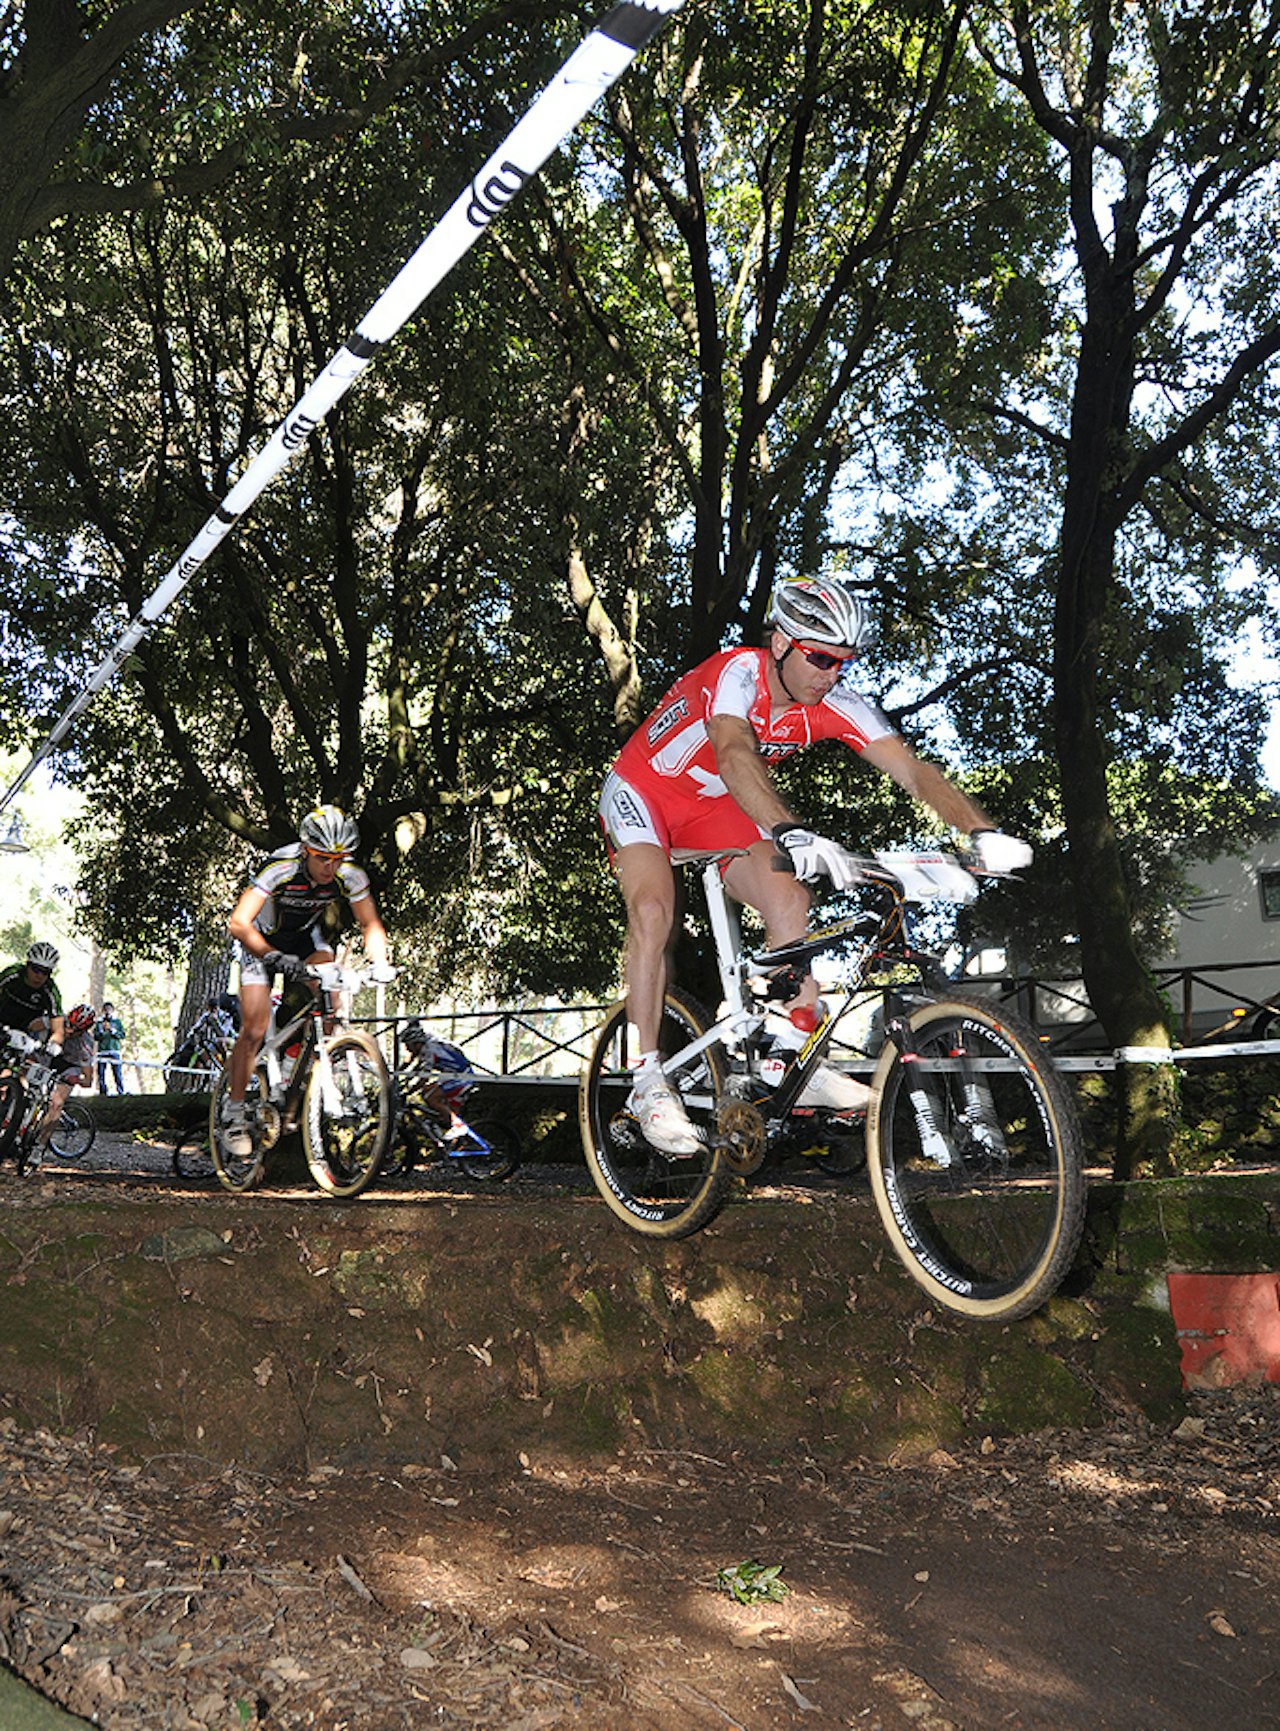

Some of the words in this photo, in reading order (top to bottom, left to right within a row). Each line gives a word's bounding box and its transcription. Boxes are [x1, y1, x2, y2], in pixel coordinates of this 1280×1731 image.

[962, 1018, 1018, 1060] RITCHEY
[596, 1150, 625, 1200] CARBON
[623, 1200, 665, 1221] RITCHEY
[884, 1175, 917, 1249] CARBON
[915, 1251, 968, 1294] RITCHEY
